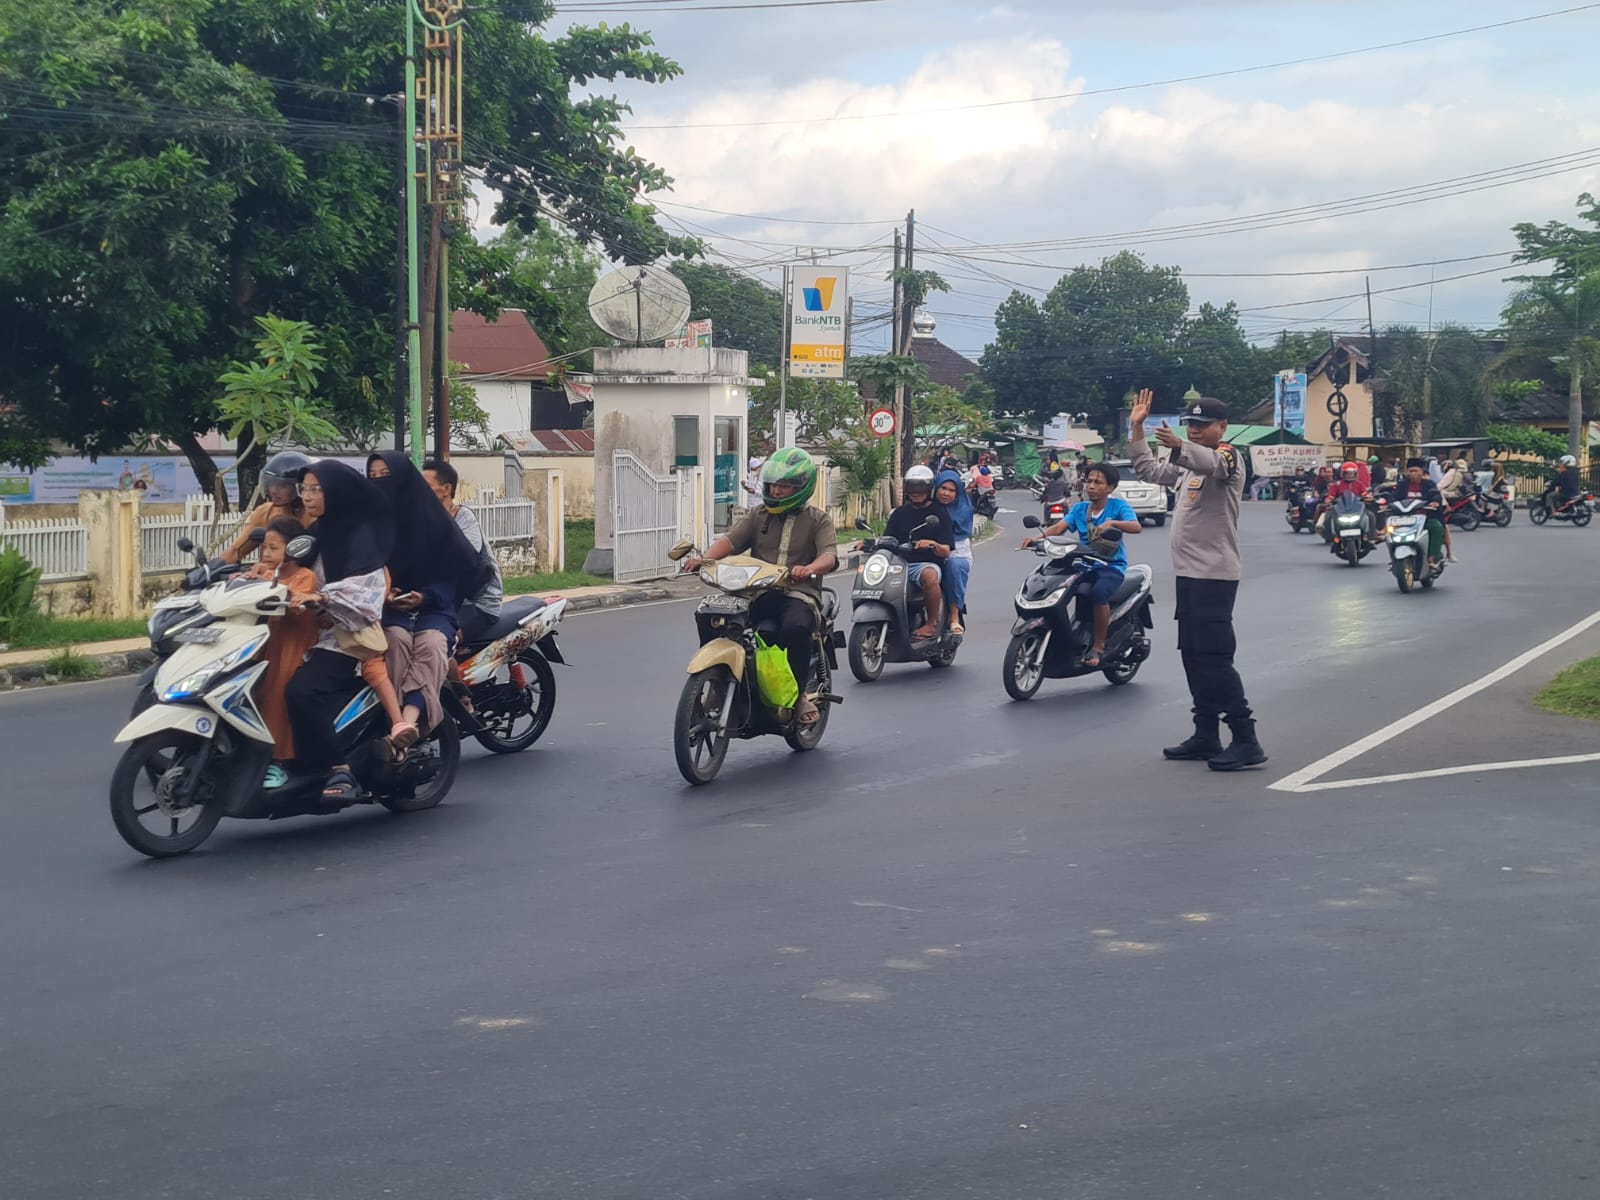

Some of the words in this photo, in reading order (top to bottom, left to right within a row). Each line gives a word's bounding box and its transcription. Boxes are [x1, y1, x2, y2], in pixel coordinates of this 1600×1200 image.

[794, 315, 841, 325] BankNTB
[815, 346, 842, 358] atm
[873, 417, 884, 428] 30
[1292, 447, 1322, 456] KUMIS
